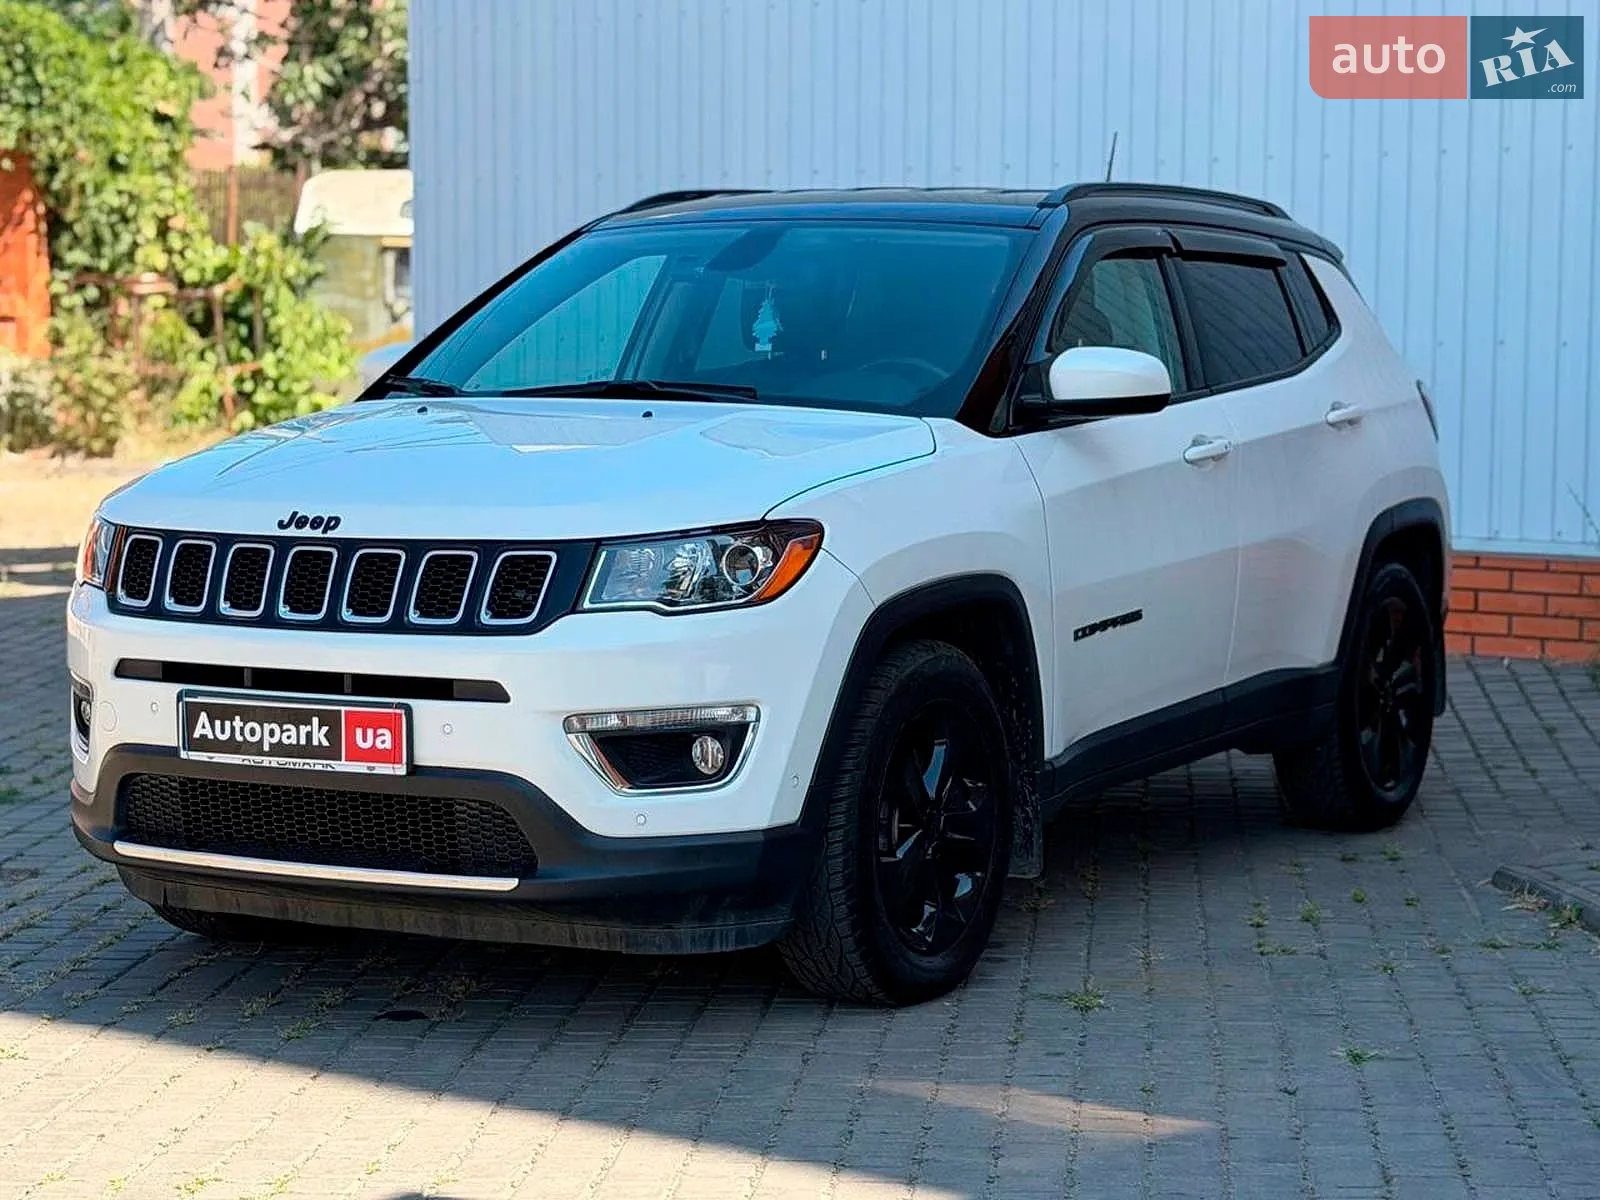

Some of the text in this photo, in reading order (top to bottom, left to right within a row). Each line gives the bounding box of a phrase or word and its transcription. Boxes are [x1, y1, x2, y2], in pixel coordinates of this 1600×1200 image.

[277, 511, 341, 534] Jeep
[193, 711, 393, 752] Autopark ua
